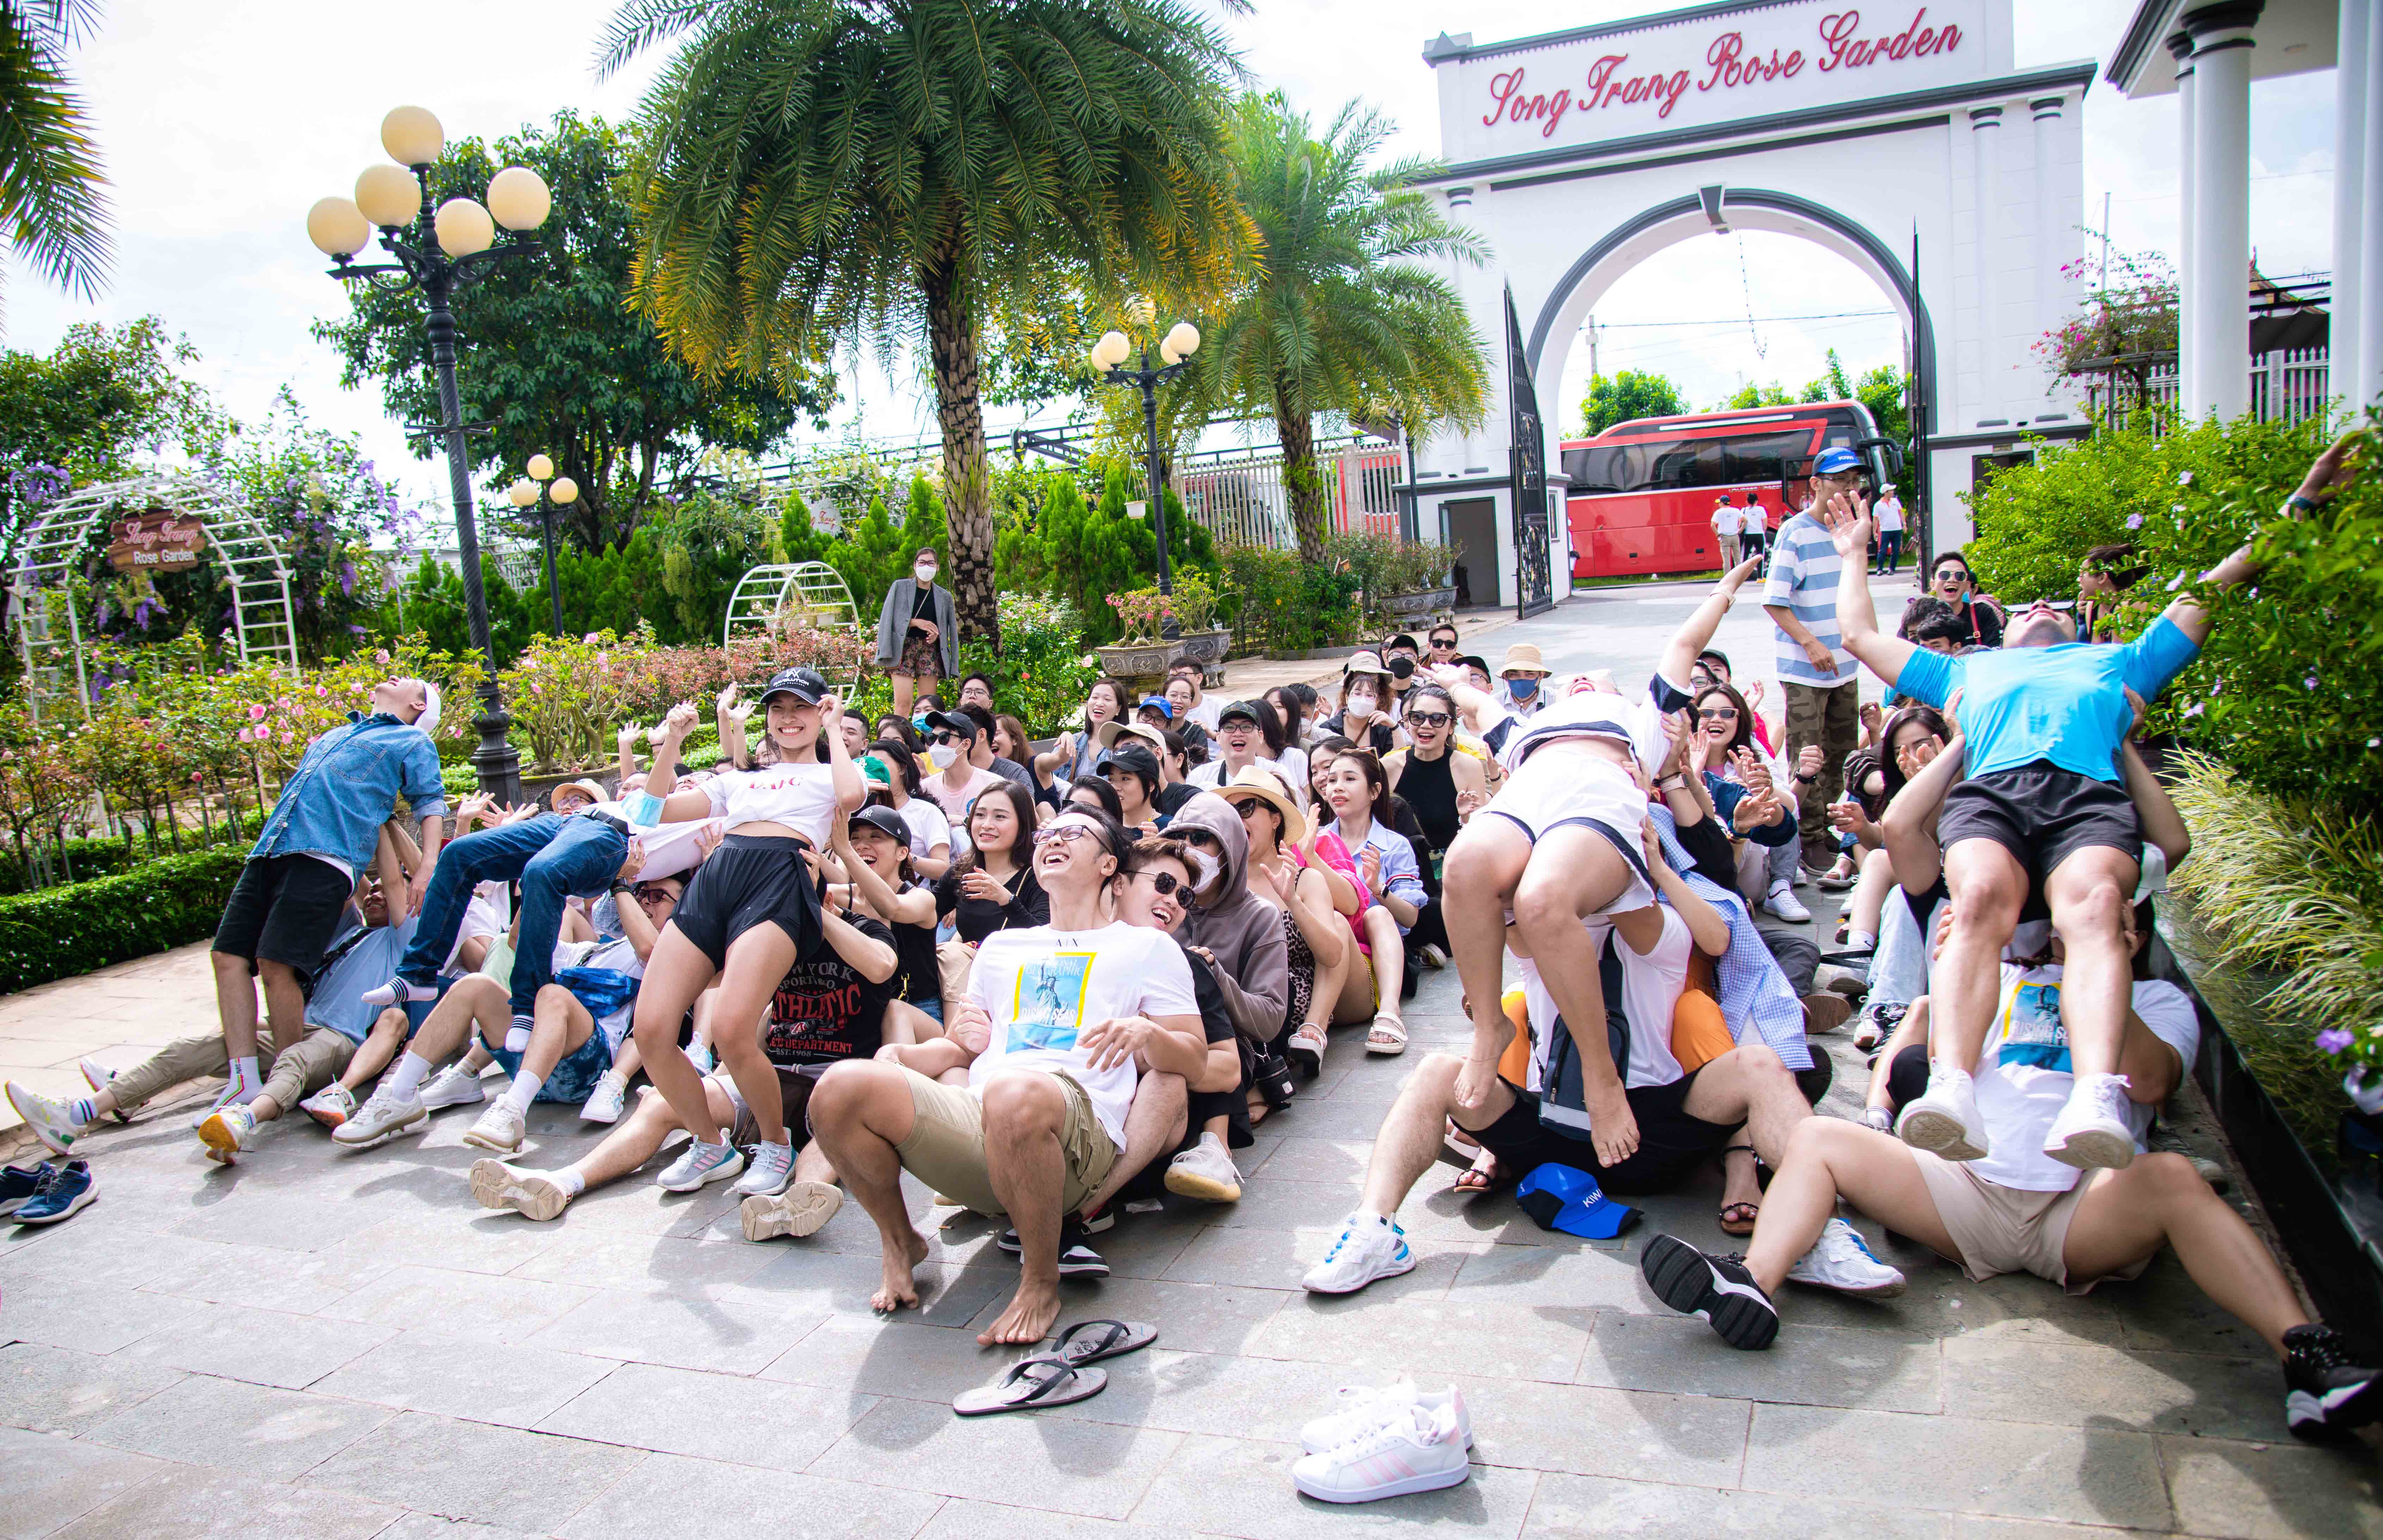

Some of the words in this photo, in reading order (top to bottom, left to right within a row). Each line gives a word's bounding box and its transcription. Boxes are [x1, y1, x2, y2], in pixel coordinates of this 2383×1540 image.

[1482, 67, 1571, 138] Song
[1578, 53, 1690, 119] Trang
[1697, 32, 1805, 91] Rose
[1818, 7, 1962, 72] Garden
[133, 551, 159, 565] Rose
[161, 548, 195, 563] Garden
